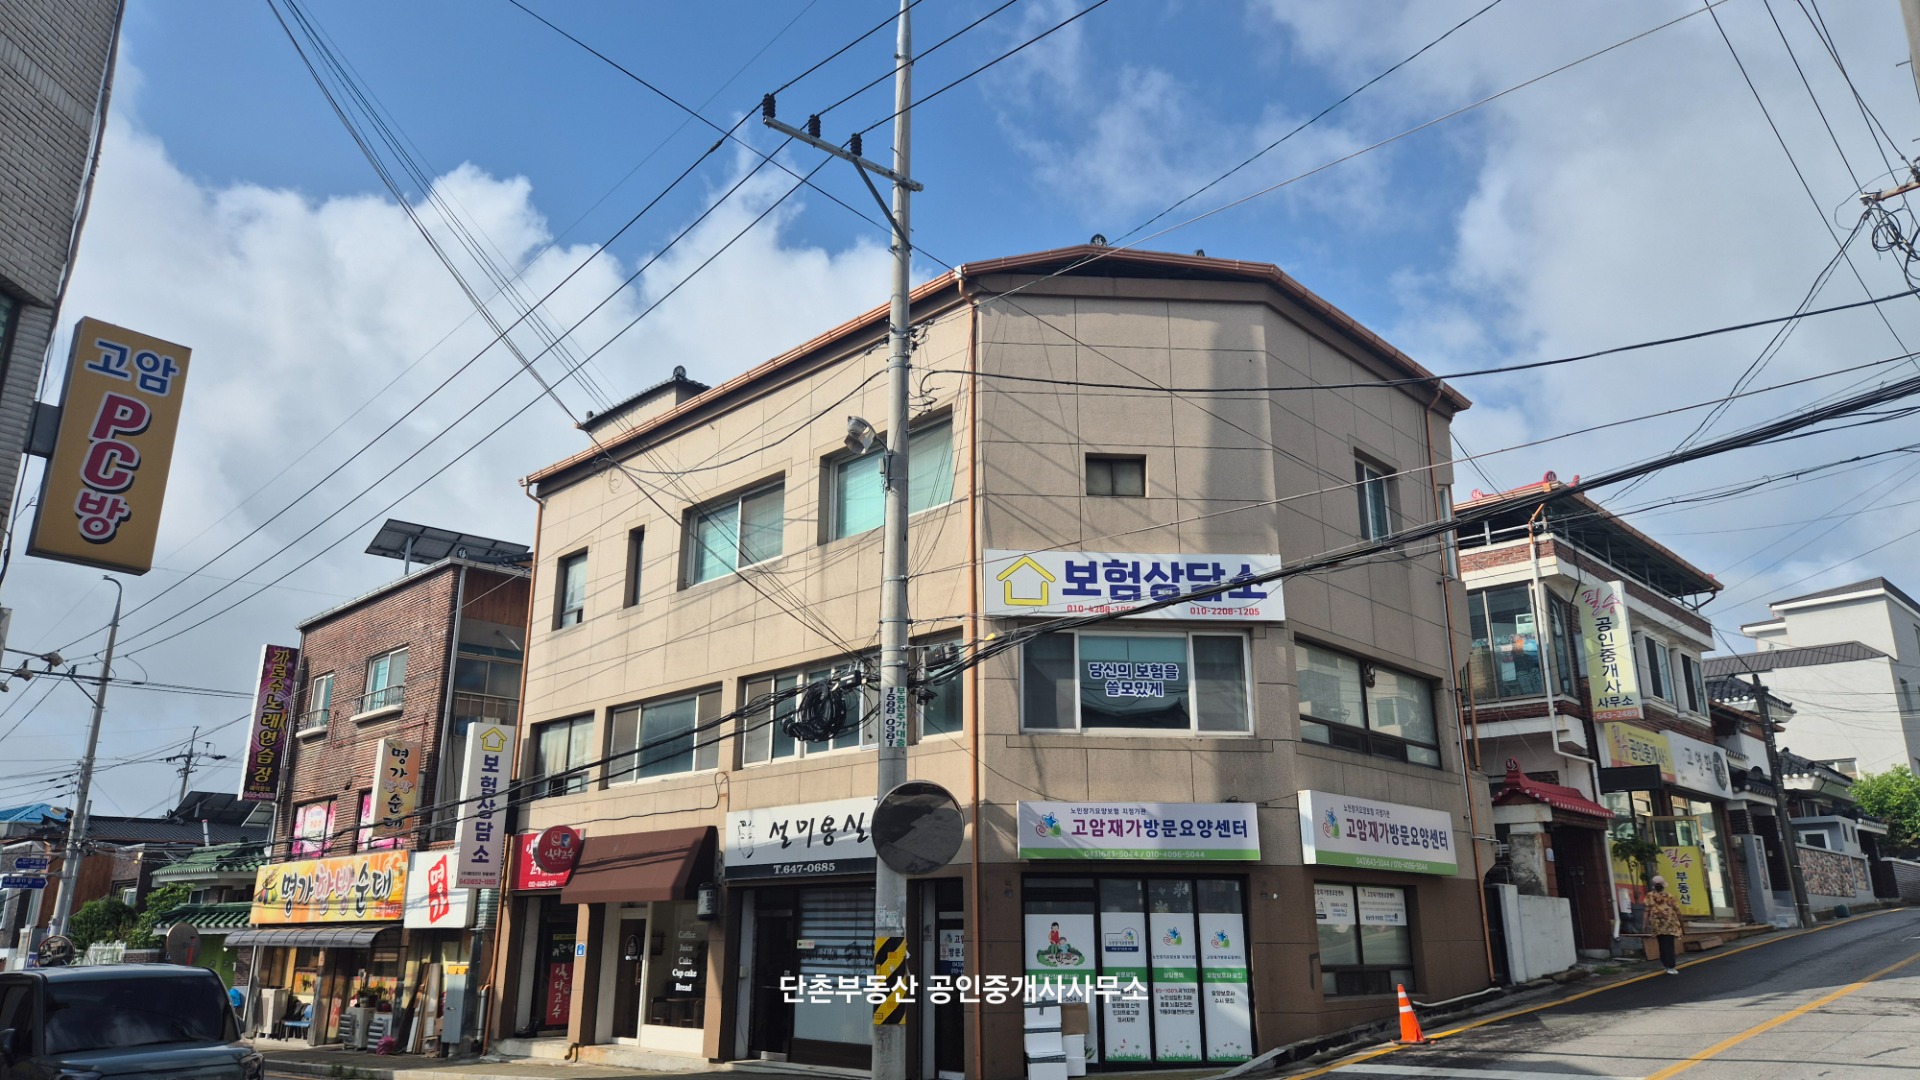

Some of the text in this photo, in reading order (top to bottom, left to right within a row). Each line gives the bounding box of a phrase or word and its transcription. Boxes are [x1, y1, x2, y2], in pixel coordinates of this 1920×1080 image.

[85, 338, 180, 397] 고암
[75, 391, 151, 543] PC방
[1062, 559, 1267, 602] 보험상담소
[1190, 607, 1260, 615] 010-2208-1205
[1595, 616, 1622, 694] 공인중개사
[1088, 662, 1180, 680] 당신의 보험을
[1105, 681, 1164, 697] 쓸모있게
[1598, 695, 1634, 708] 사무소
[254, 650, 289, 782] 가로수노래연습장
[471, 755, 499, 863] 보험상담소
[769, 812, 870, 849] 설미용실
[1071, 819, 1248, 838] 고암재가방문요양센터
[1346, 817, 1448, 851] 고암재가방문요양센터
[773, 862, 836, 875] T.647-0685
[1675, 871, 1691, 905] 부동산
[678, 930, 696, 939] Coffee
[679, 944, 693, 952] Juice
[678, 956, 692, 965] Cake
[672, 968, 697, 979] Cup cake
[675, 983, 692, 992] Bread
